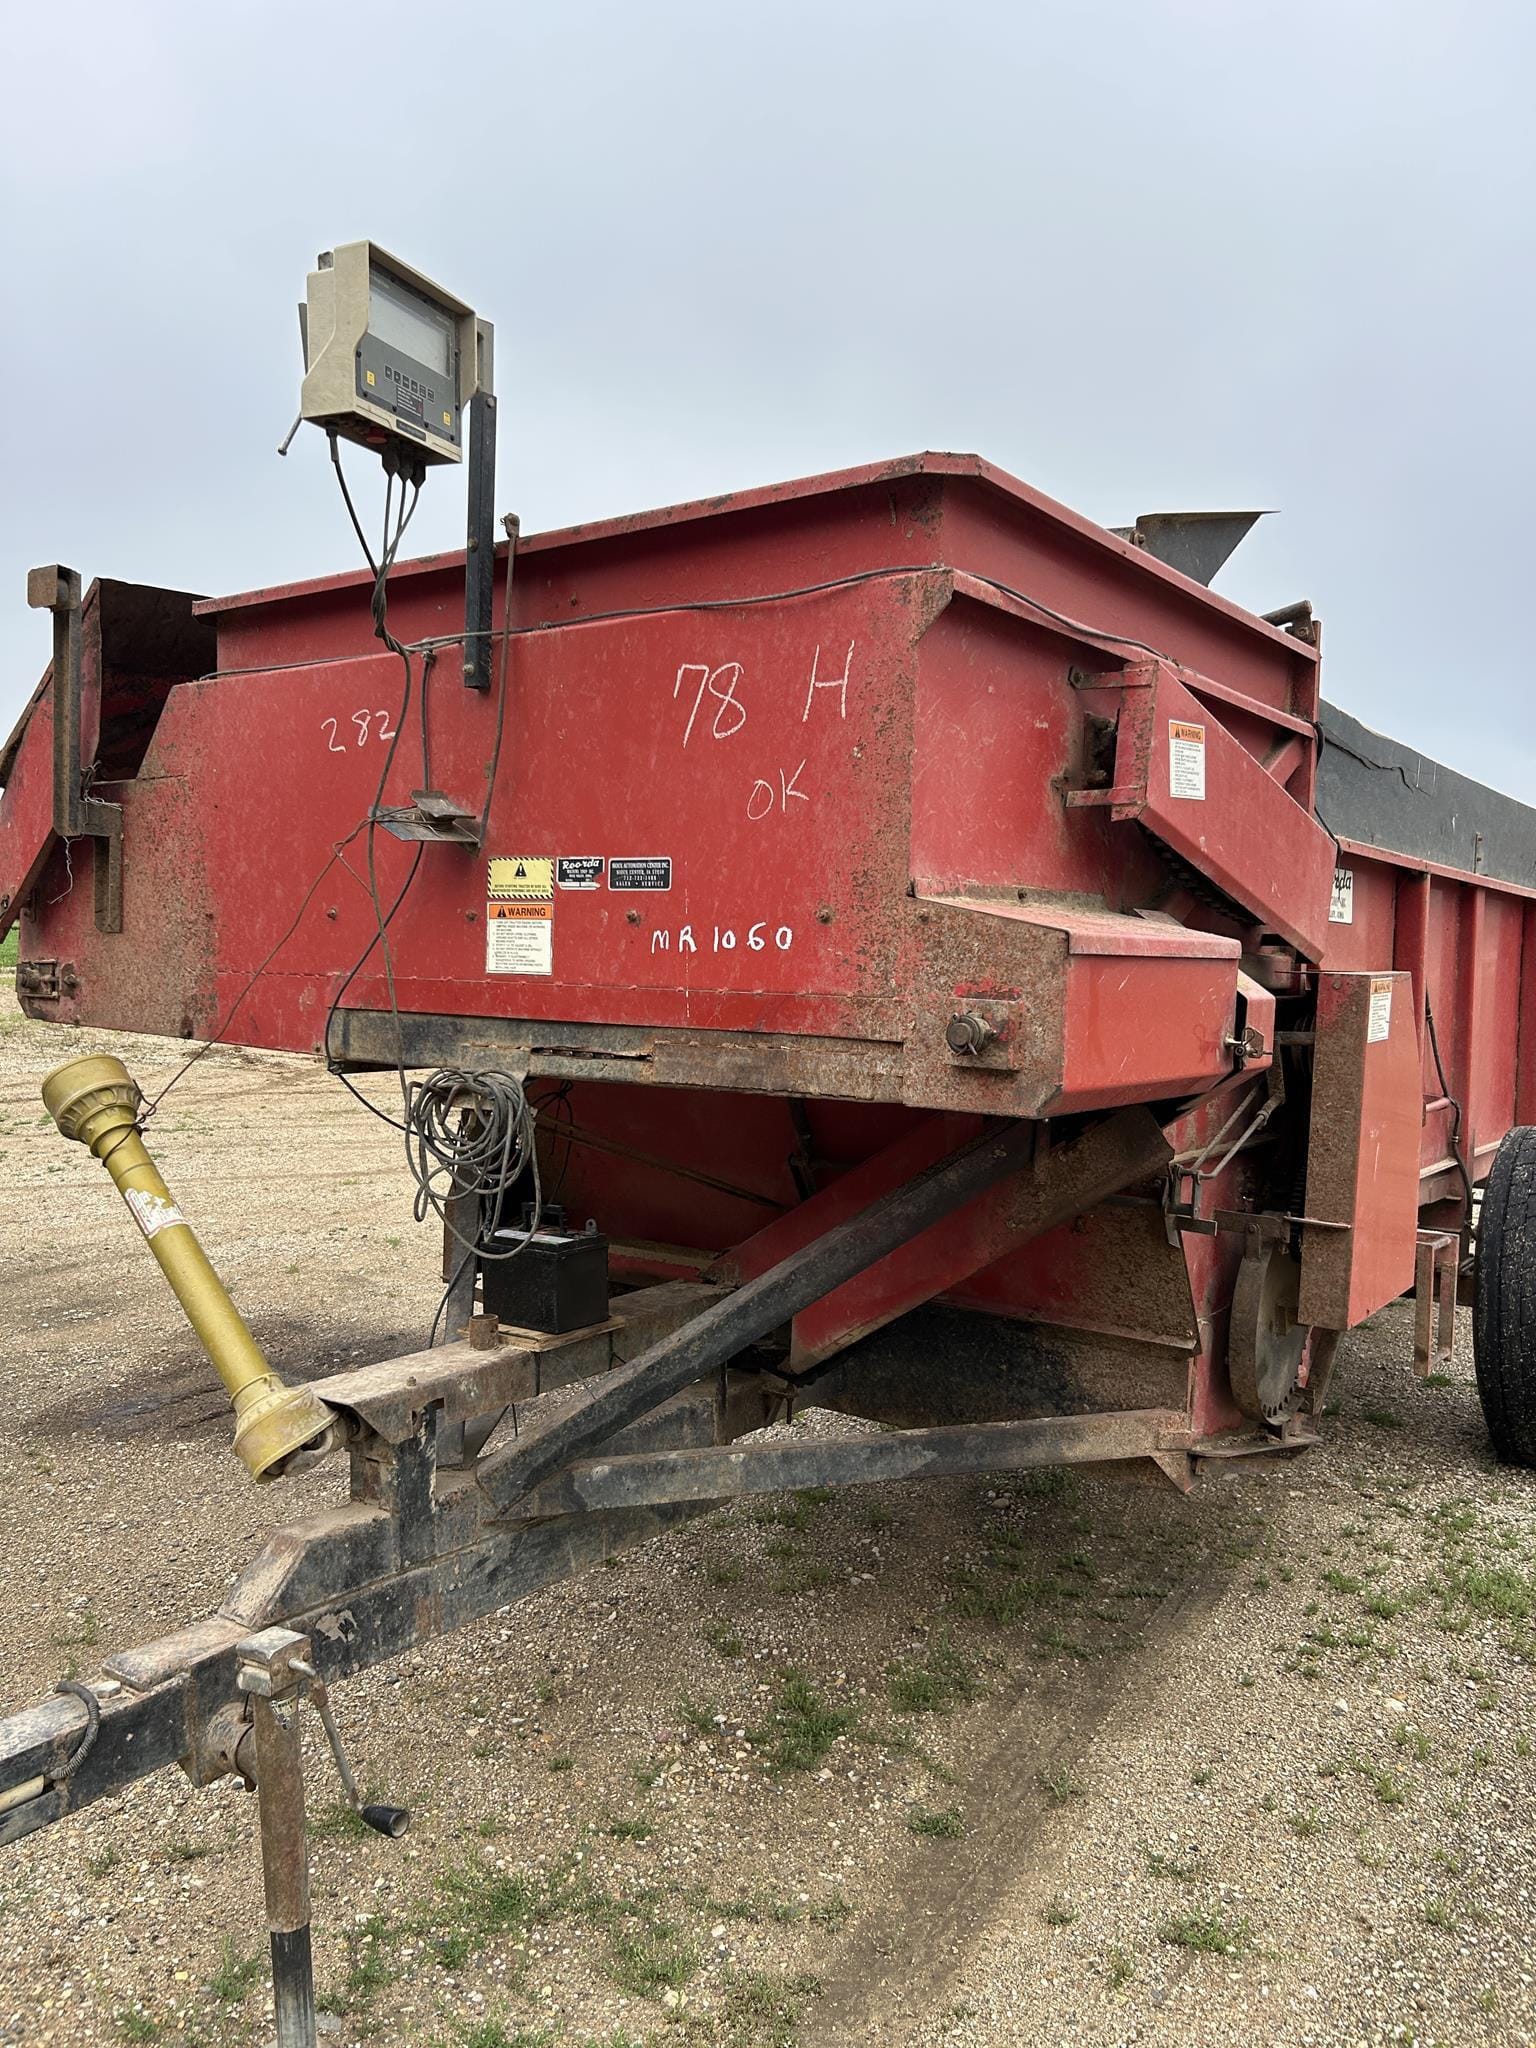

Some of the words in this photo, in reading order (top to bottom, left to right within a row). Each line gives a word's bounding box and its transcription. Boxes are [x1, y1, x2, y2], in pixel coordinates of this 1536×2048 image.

[673, 662, 746, 748] 78
[802, 639, 855, 722] H
[320, 708, 396, 752] 282
[747, 758, 809, 819] OK
[562, 859, 600, 870] Roorda
[507, 907, 546, 917] WARNING
